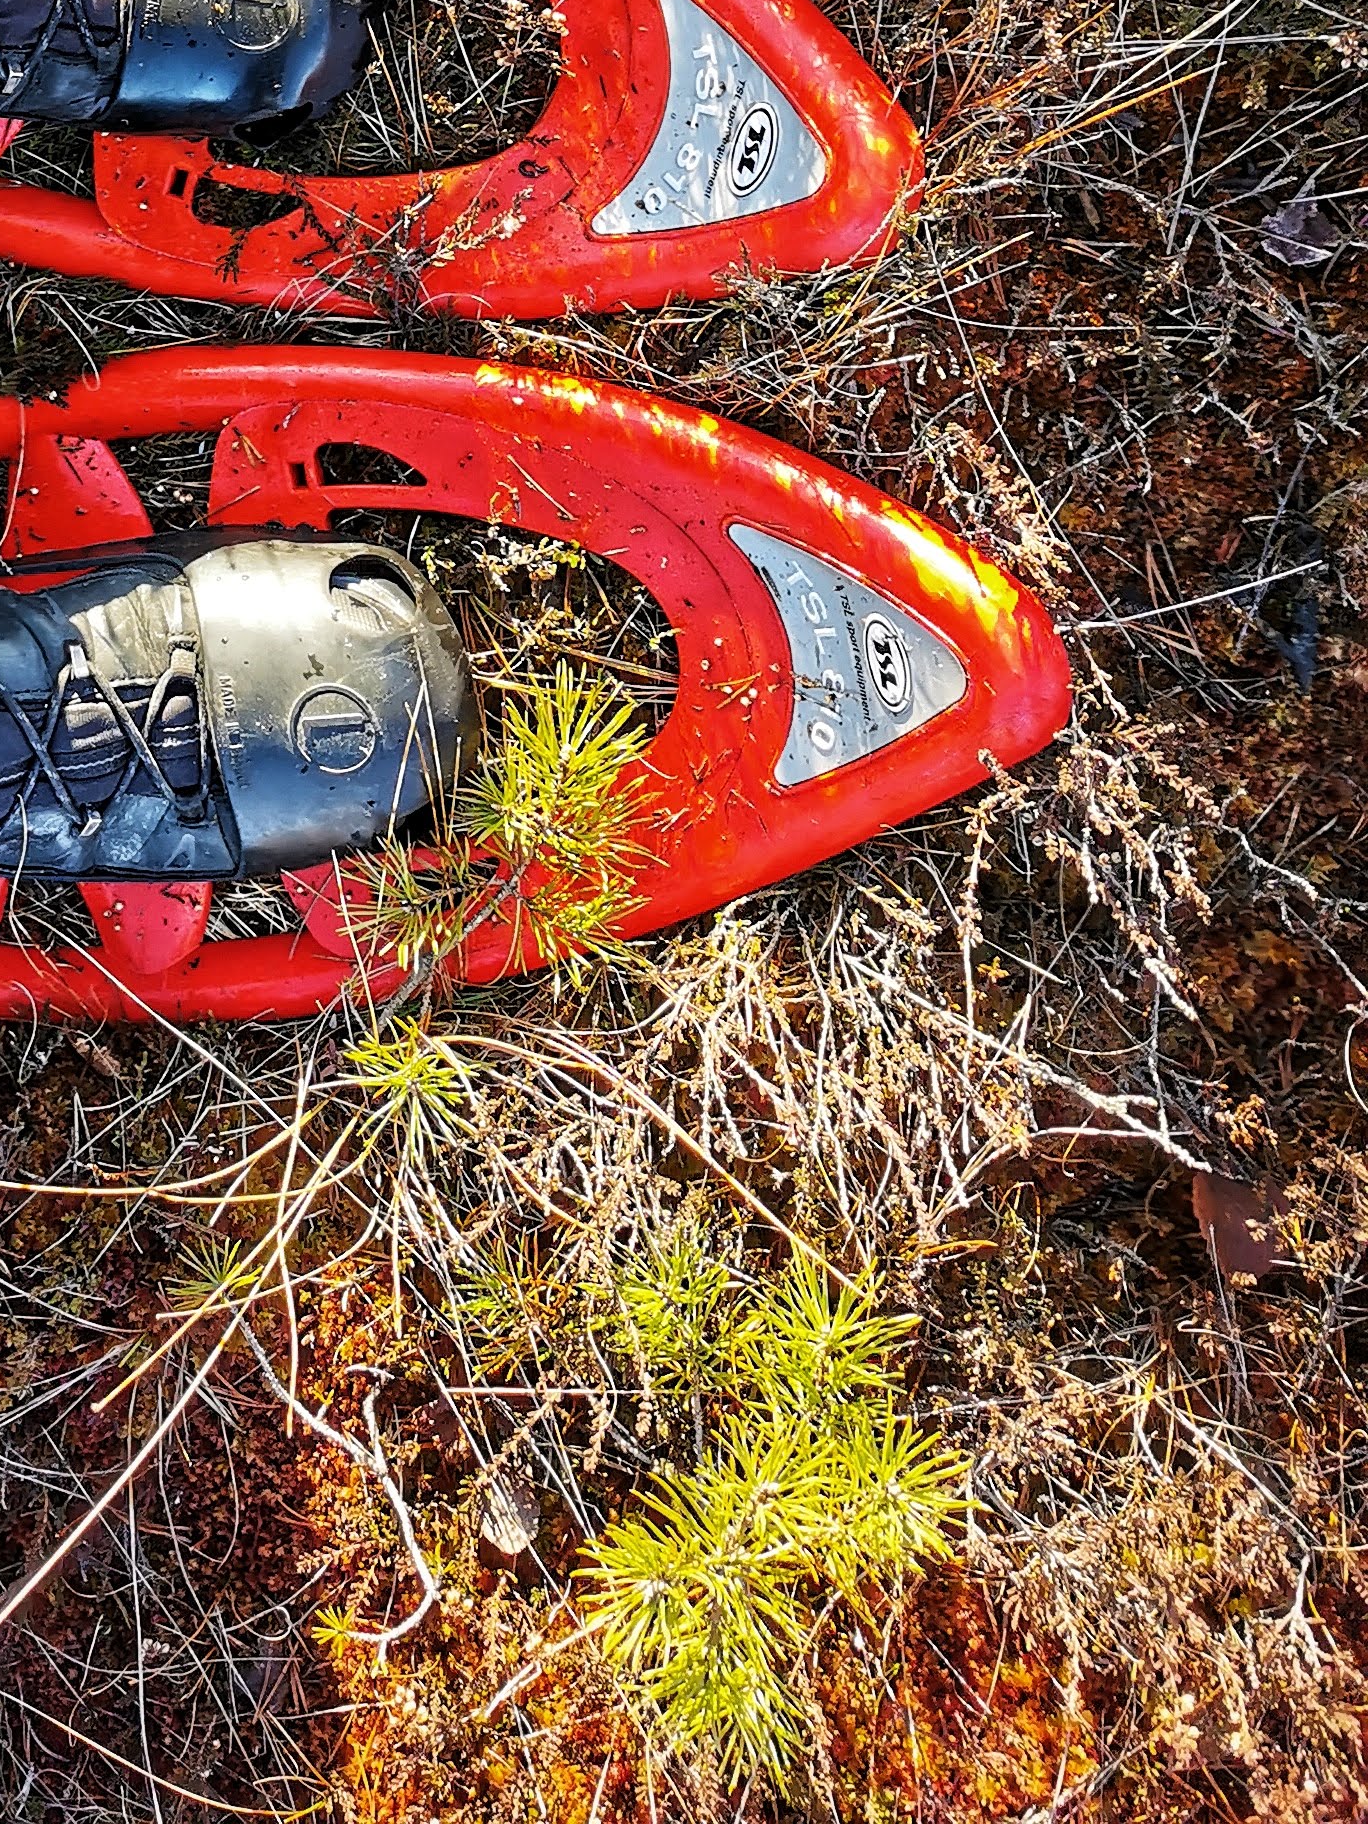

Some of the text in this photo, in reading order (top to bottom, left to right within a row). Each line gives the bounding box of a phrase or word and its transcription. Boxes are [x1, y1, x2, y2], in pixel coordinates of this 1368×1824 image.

[734, 79, 747, 101] TSL
[643, 33, 722, 214] TSL 810
[737, 125, 766, 174] TSL
[786, 560, 837, 655] TSL
[839, 594, 872, 722] TSL sport equipment
[872, 639, 897, 689] TSL
[218, 674, 237, 717] MADE
